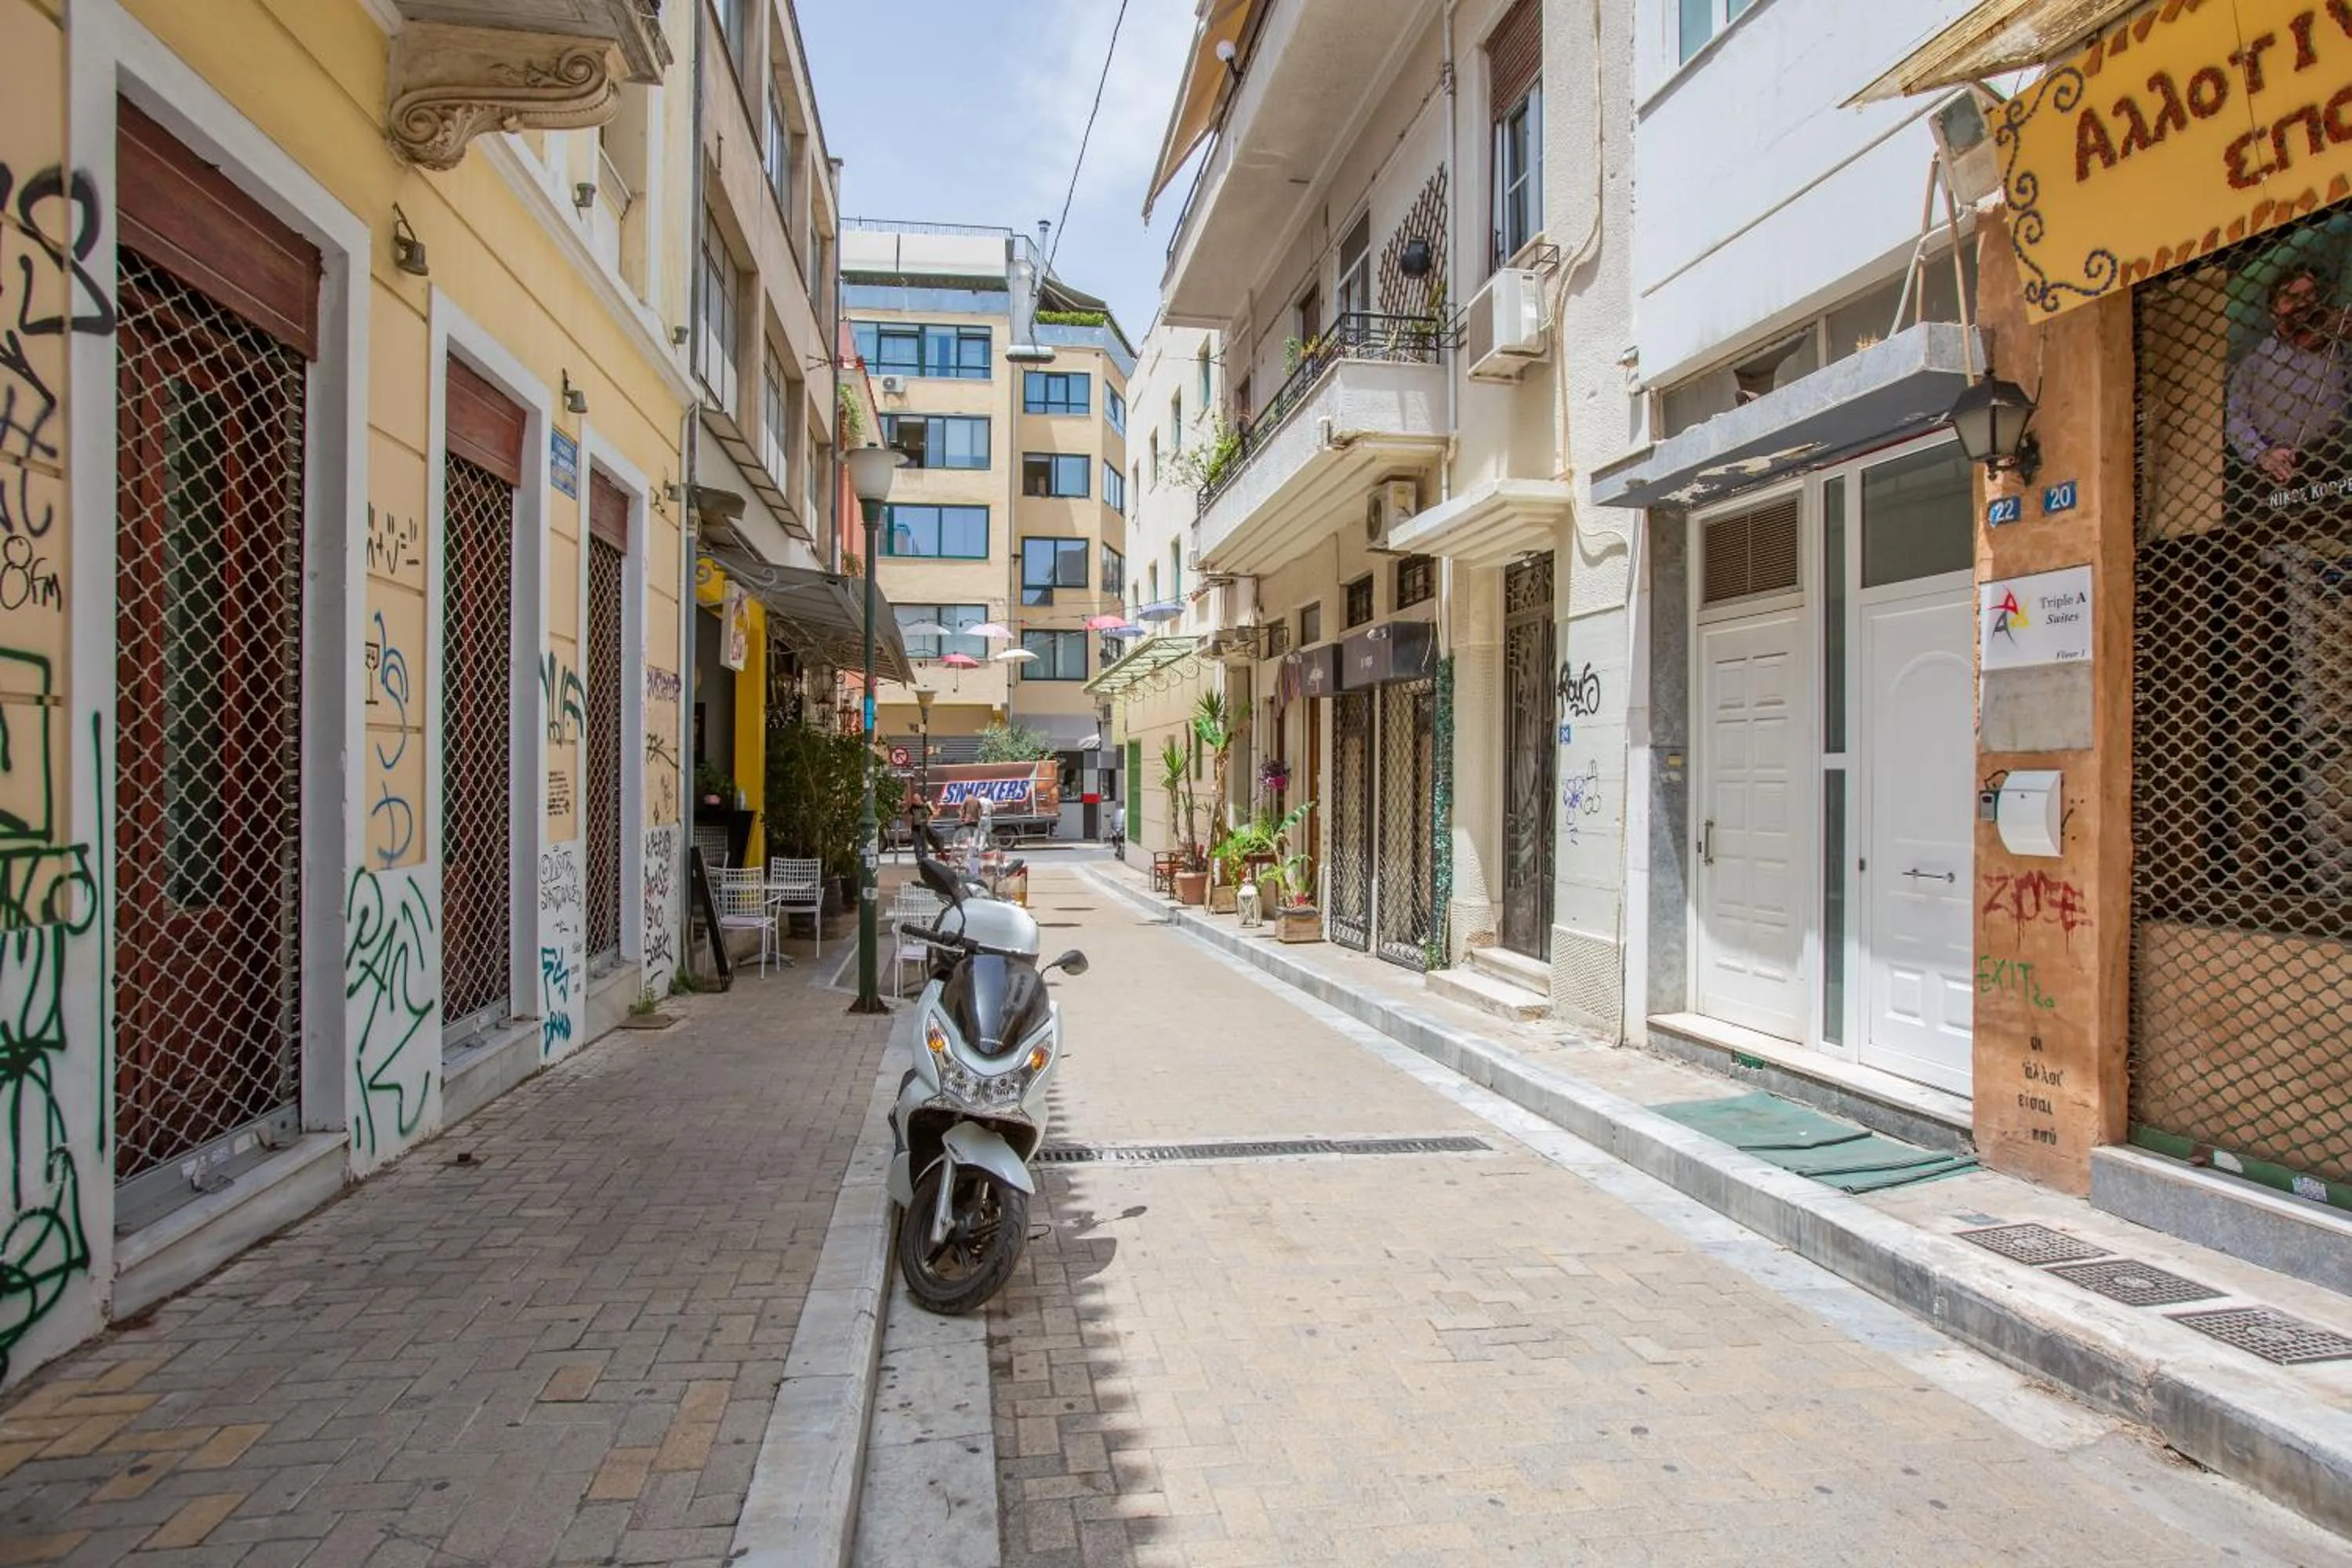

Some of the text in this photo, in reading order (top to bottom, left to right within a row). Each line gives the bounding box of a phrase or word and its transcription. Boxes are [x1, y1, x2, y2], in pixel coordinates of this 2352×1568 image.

[2050, 485, 2071, 510] 20
[1996, 499, 2014, 521] 22
[2040, 590, 2086, 610] Triple A
[2045, 612, 2080, 626] Suites
[943, 779, 1030, 804] SNICKERS
